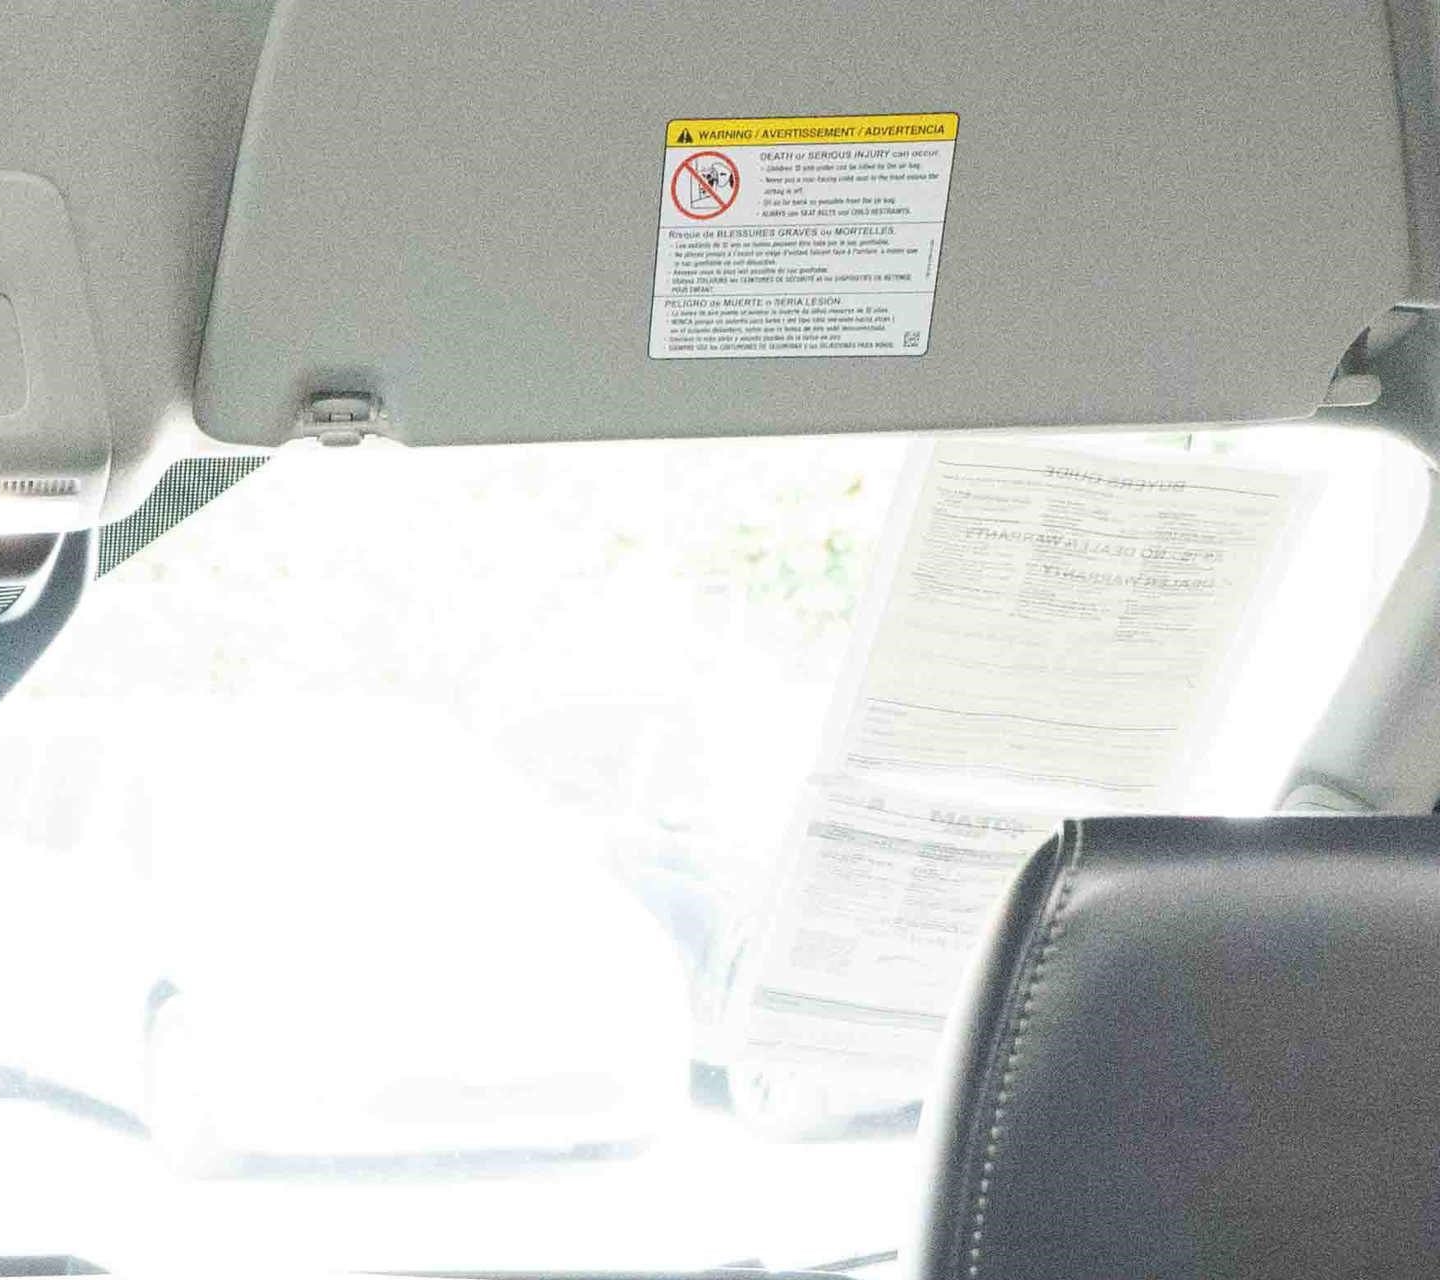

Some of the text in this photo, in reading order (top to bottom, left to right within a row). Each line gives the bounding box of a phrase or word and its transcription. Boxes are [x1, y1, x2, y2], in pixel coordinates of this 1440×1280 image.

[698, 129, 752, 141] WARNING
[760, 126, 856, 140] AVERTISSEMENT
[864, 123, 945, 137] ADVERTENCIA
[760, 151, 794, 161] DEATH
[807, 150, 851, 160] SERIOUS
[854, 149, 891, 159] INJURY
[716, 227, 776, 239] BLESSURES
[777, 226, 818, 238] GRAVES
[664, 298, 706, 309] PELIGRO
[722, 297, 763, 308] MUERTE
[774, 296, 804, 307] SERIA
